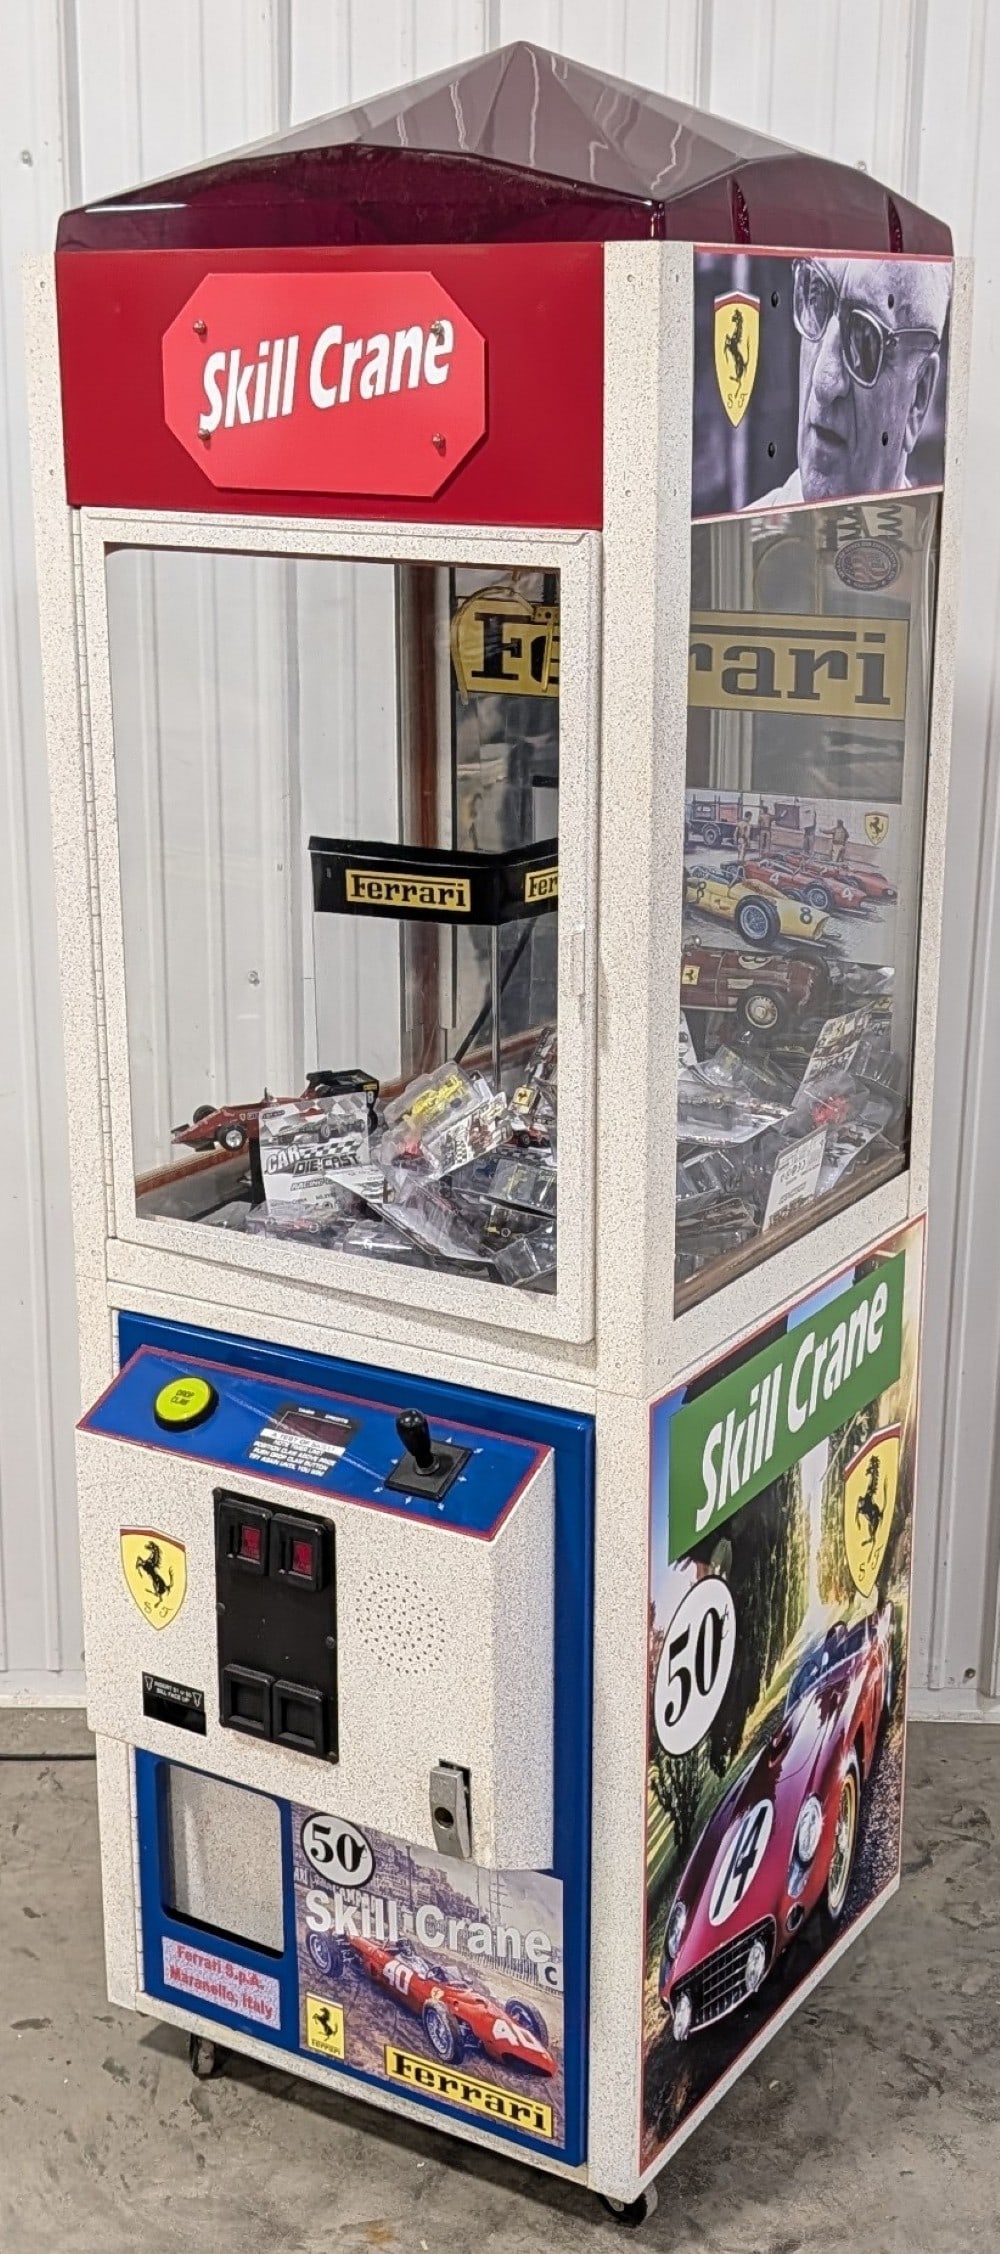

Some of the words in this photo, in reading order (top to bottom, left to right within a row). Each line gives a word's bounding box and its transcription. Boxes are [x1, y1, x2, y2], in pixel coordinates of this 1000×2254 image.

[199, 335, 299, 433] Skill
[309, 319, 455, 409] Crane
[350, 874, 466, 907] Ferrari
[800, 906, 813, 925] 8
[267, 1144, 301, 1174] CAR
[696, 1363, 782, 1532] Skill
[787, 1282, 888, 1433] Crane
[712, 1805, 769, 1920] 14
[306, 1889, 399, 1943] Skill
[416, 1904, 552, 1964] Crane
[176, 1944, 222, 1974] Ferrari
[169, 1964, 239, 2008] Maranello,
[243, 1993, 273, 2020] Italy
[491, 2017, 548, 2055] 40
[392, 2050, 547, 2133] Ferrari
